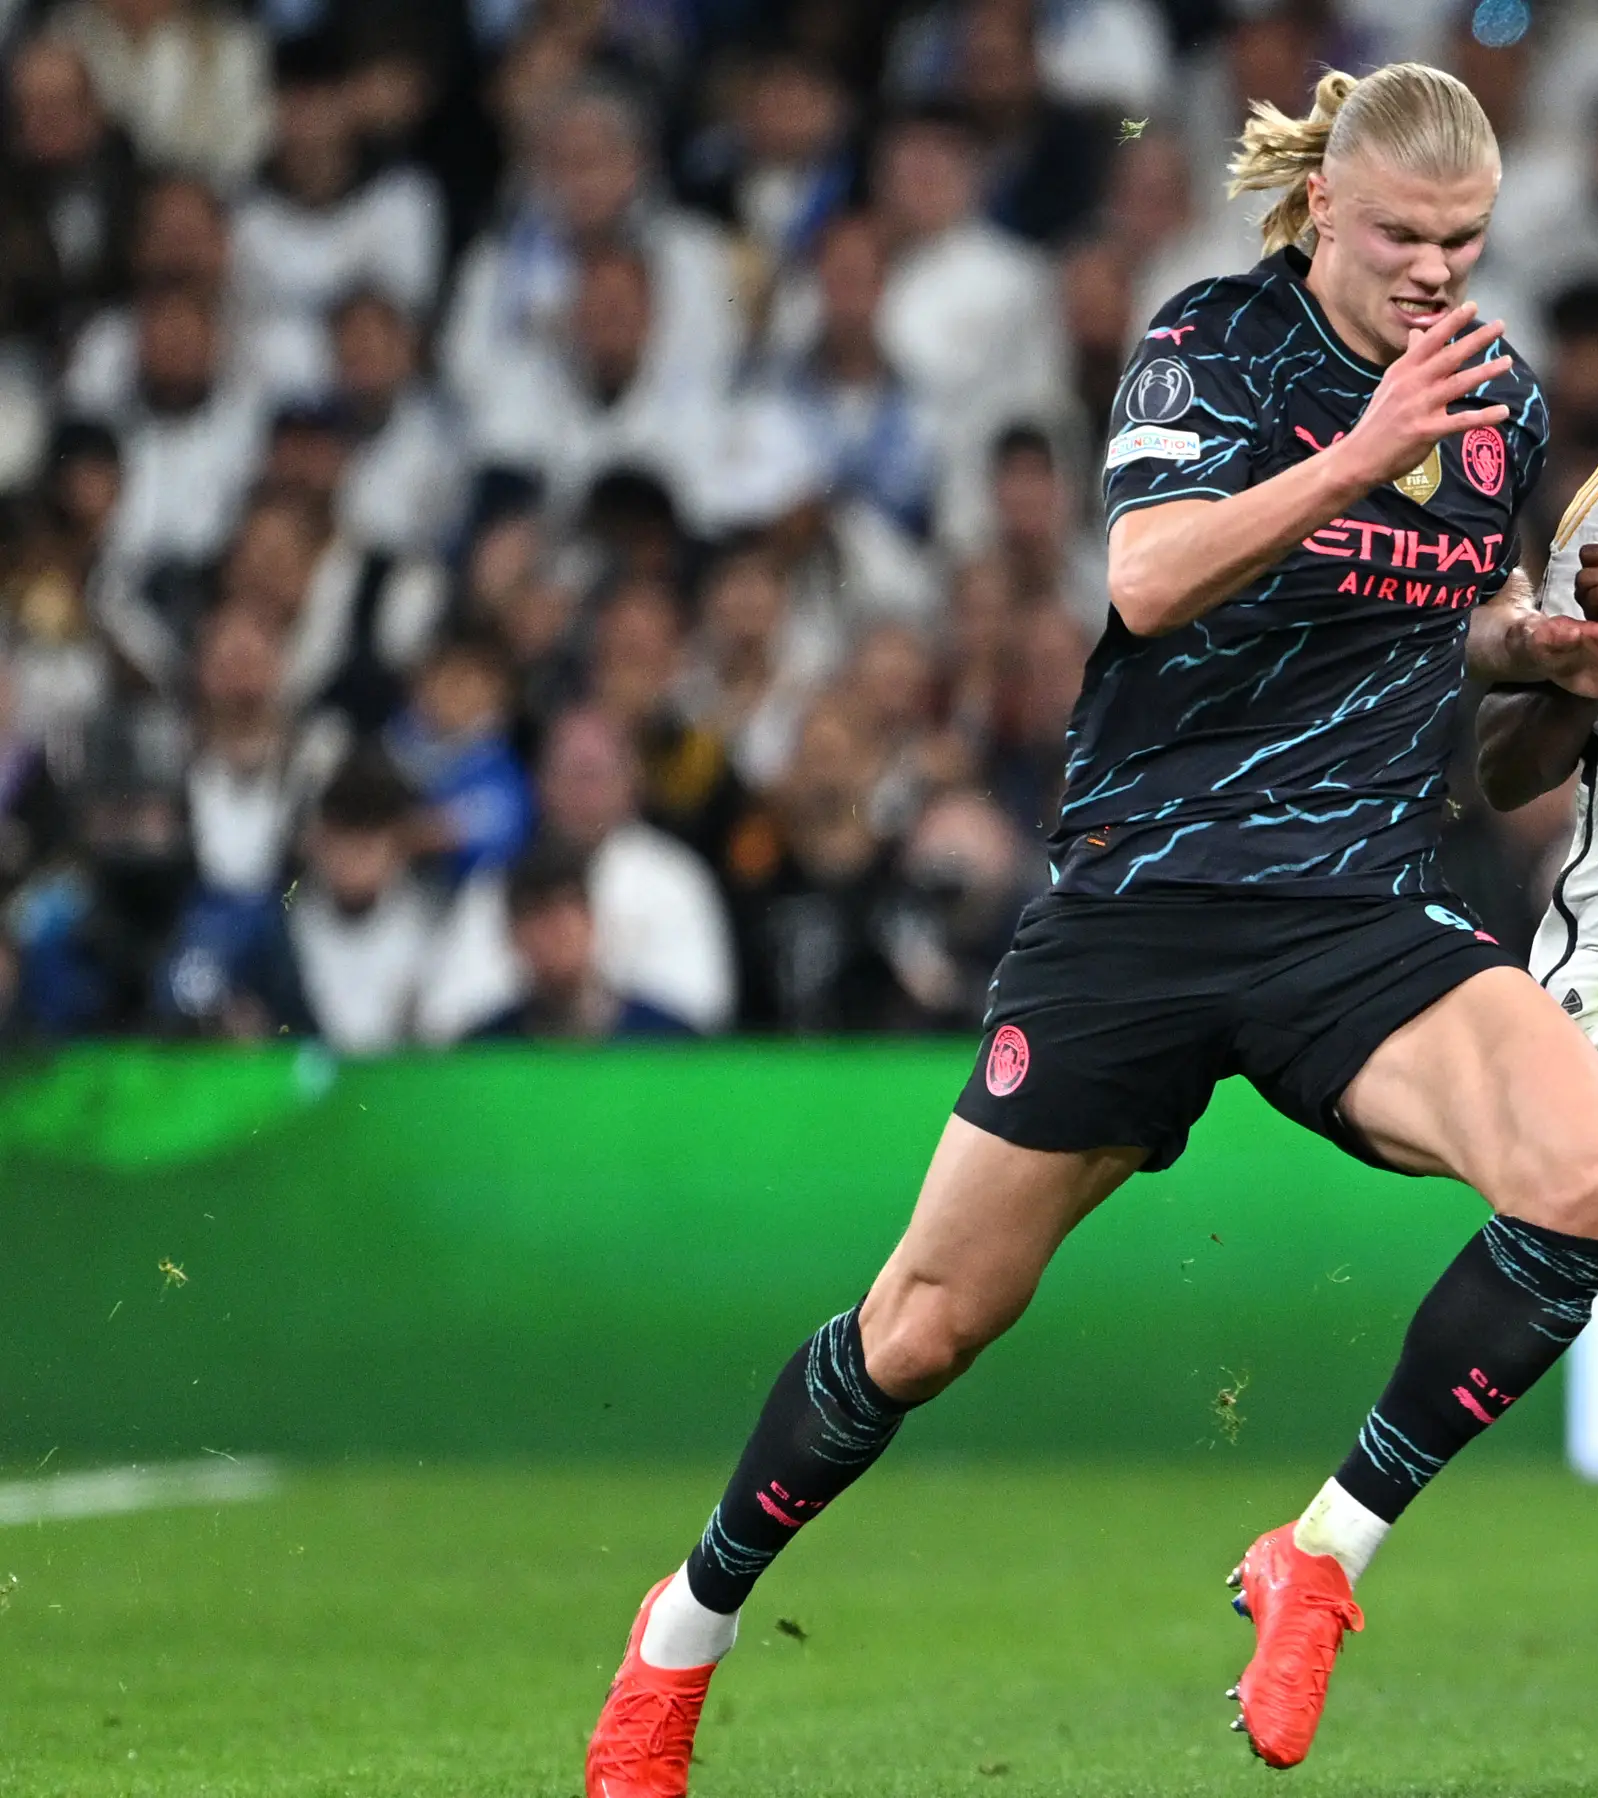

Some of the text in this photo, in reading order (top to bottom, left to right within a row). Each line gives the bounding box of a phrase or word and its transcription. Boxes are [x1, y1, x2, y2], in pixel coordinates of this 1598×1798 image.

[1111, 437, 1196, 454] UNDATION
[1406, 475, 1429, 486] FIFA
[1337, 570, 1477, 609] AIRWAYS
